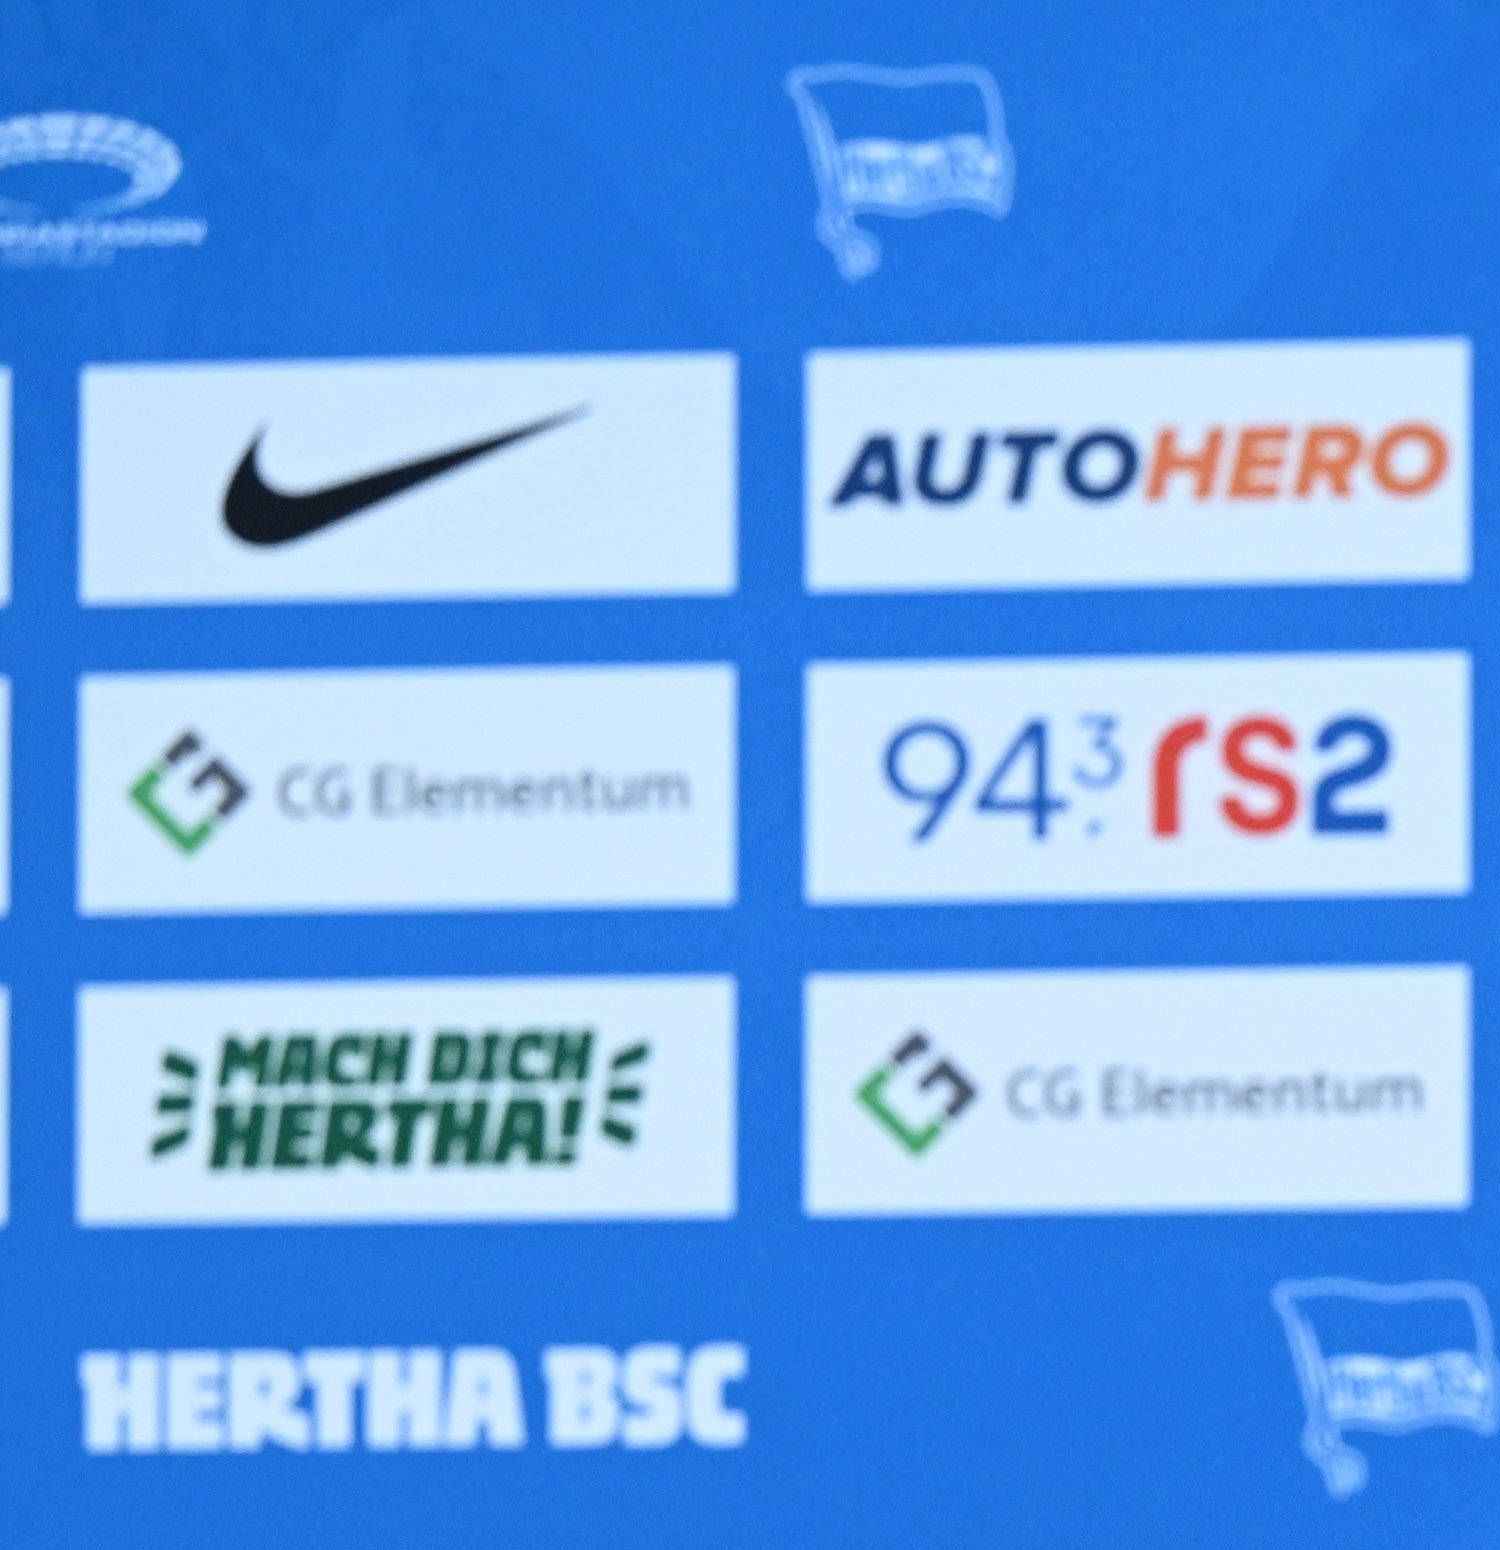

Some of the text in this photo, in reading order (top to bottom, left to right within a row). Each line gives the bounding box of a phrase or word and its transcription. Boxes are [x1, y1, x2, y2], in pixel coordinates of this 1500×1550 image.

[829, 424, 1448, 510] AUTOHERO
[274, 762, 694, 821] CG Elementum
[1150, 711, 1396, 840] rs2
[216, 1026, 598, 1090] MACH DICH
[1003, 1063, 1427, 1123] CG Elementum
[208, 1094, 586, 1173] HERTHA!
[78, 1341, 749, 1455] HERTHA BSC
